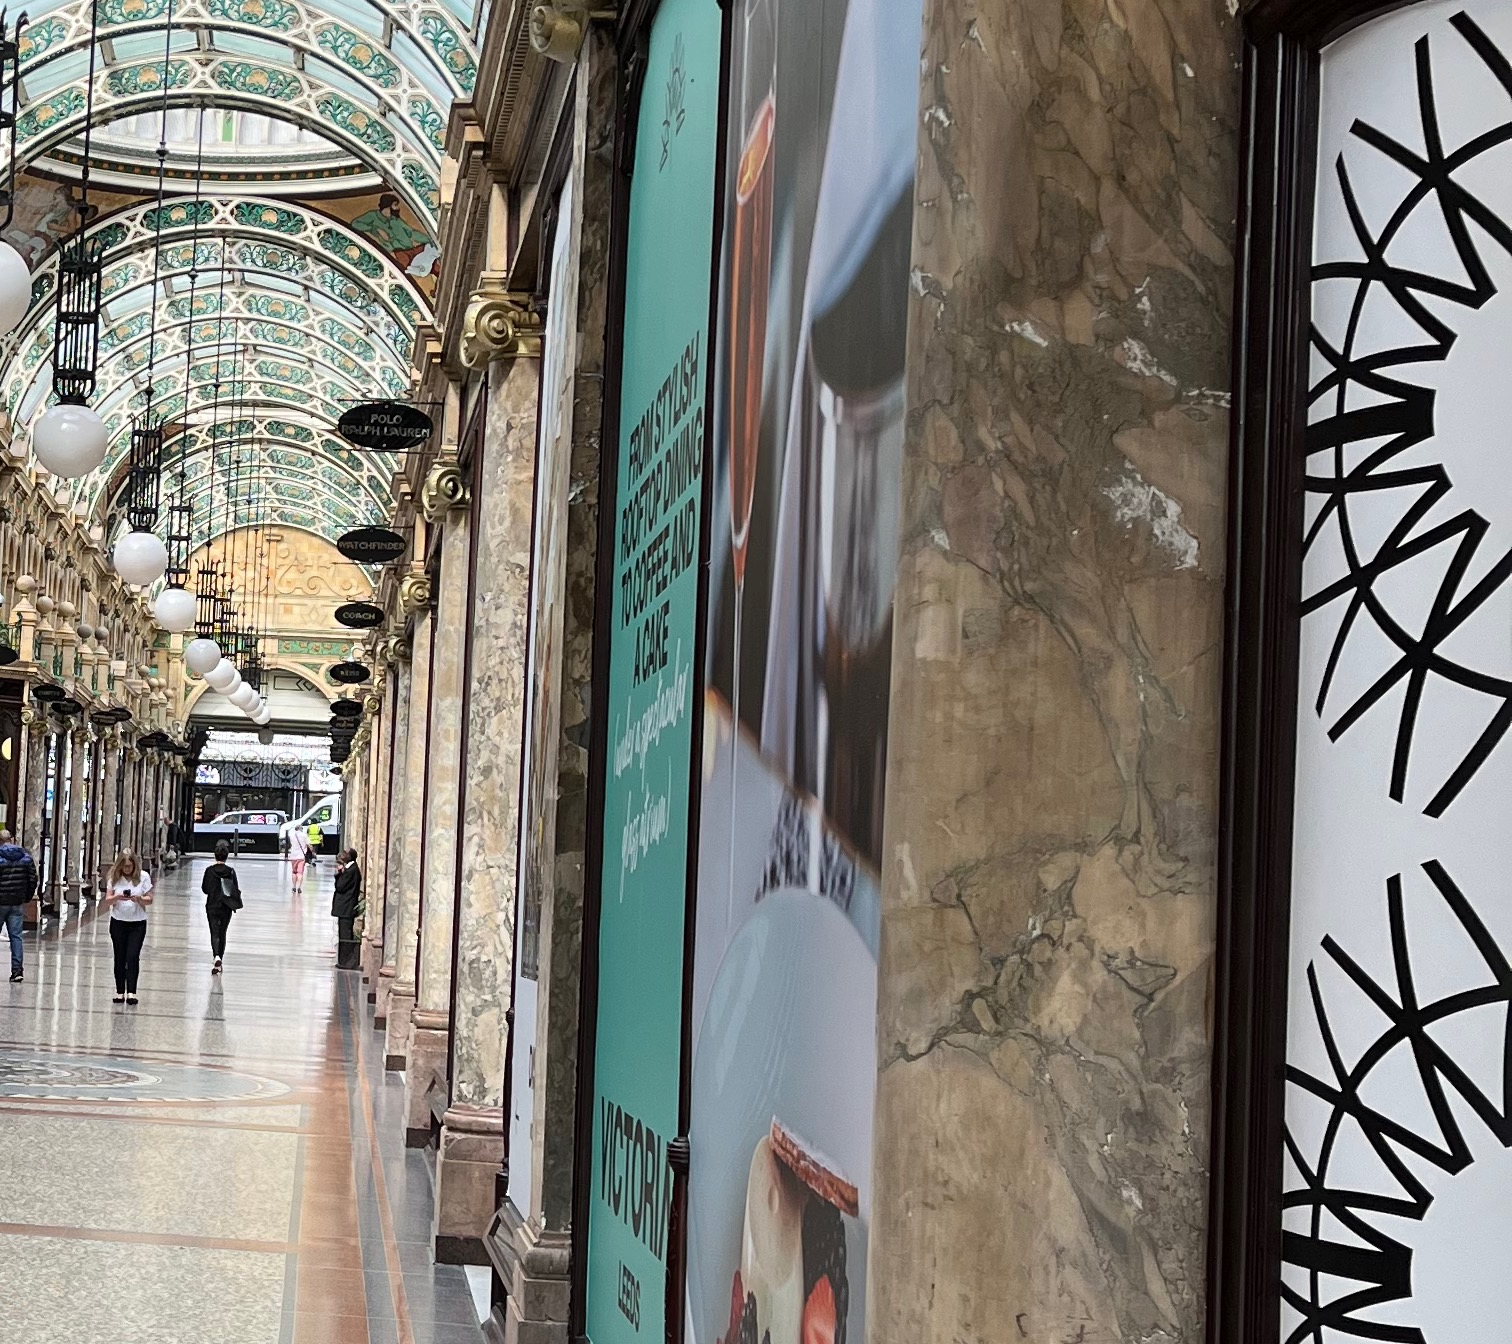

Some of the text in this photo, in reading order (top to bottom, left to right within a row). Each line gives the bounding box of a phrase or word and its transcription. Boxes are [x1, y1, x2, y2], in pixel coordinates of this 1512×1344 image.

[341, 424, 431, 439] RALPH LAUREN
[370, 413, 403, 425] POLO
[628, 329, 700, 492] FROM STYLISH
[620, 406, 703, 567] ROOFTOP DINING
[338, 541, 406, 551] WATCHFINDER
[621, 497, 696, 631] TO COFFEE AND
[342, 611, 376, 620] COACH
[633, 599, 671, 689] A CAKE
[618, 1260, 640, 1333] LEEDS
